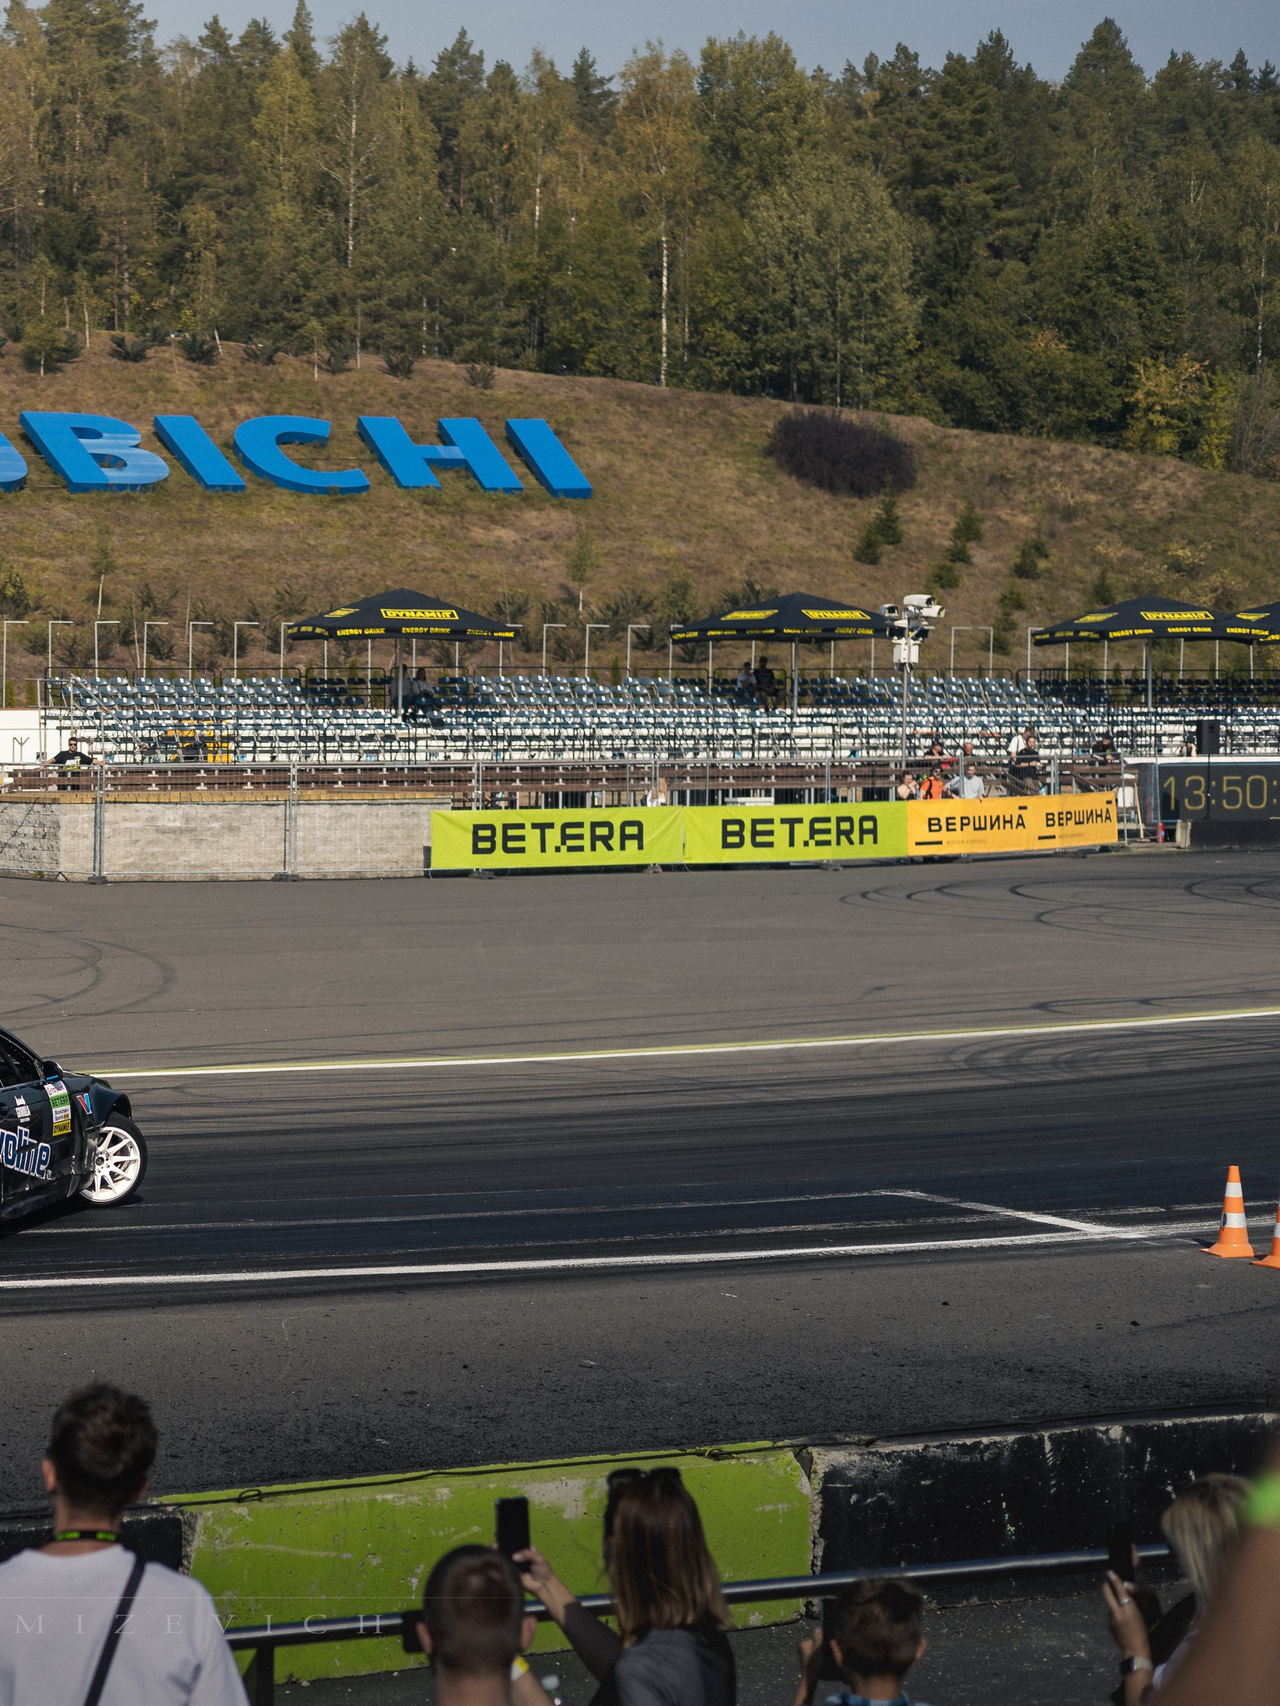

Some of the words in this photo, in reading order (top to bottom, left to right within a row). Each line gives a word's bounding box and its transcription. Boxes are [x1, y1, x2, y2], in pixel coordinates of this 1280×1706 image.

[336, 628, 363, 636] ENERGY
[1109, 629, 1133, 638] ENERGY
[1226, 627, 1250, 635] ENERGY
[721, 815, 878, 850] BET.ERA
[472, 820, 644, 855] BET.ERA
